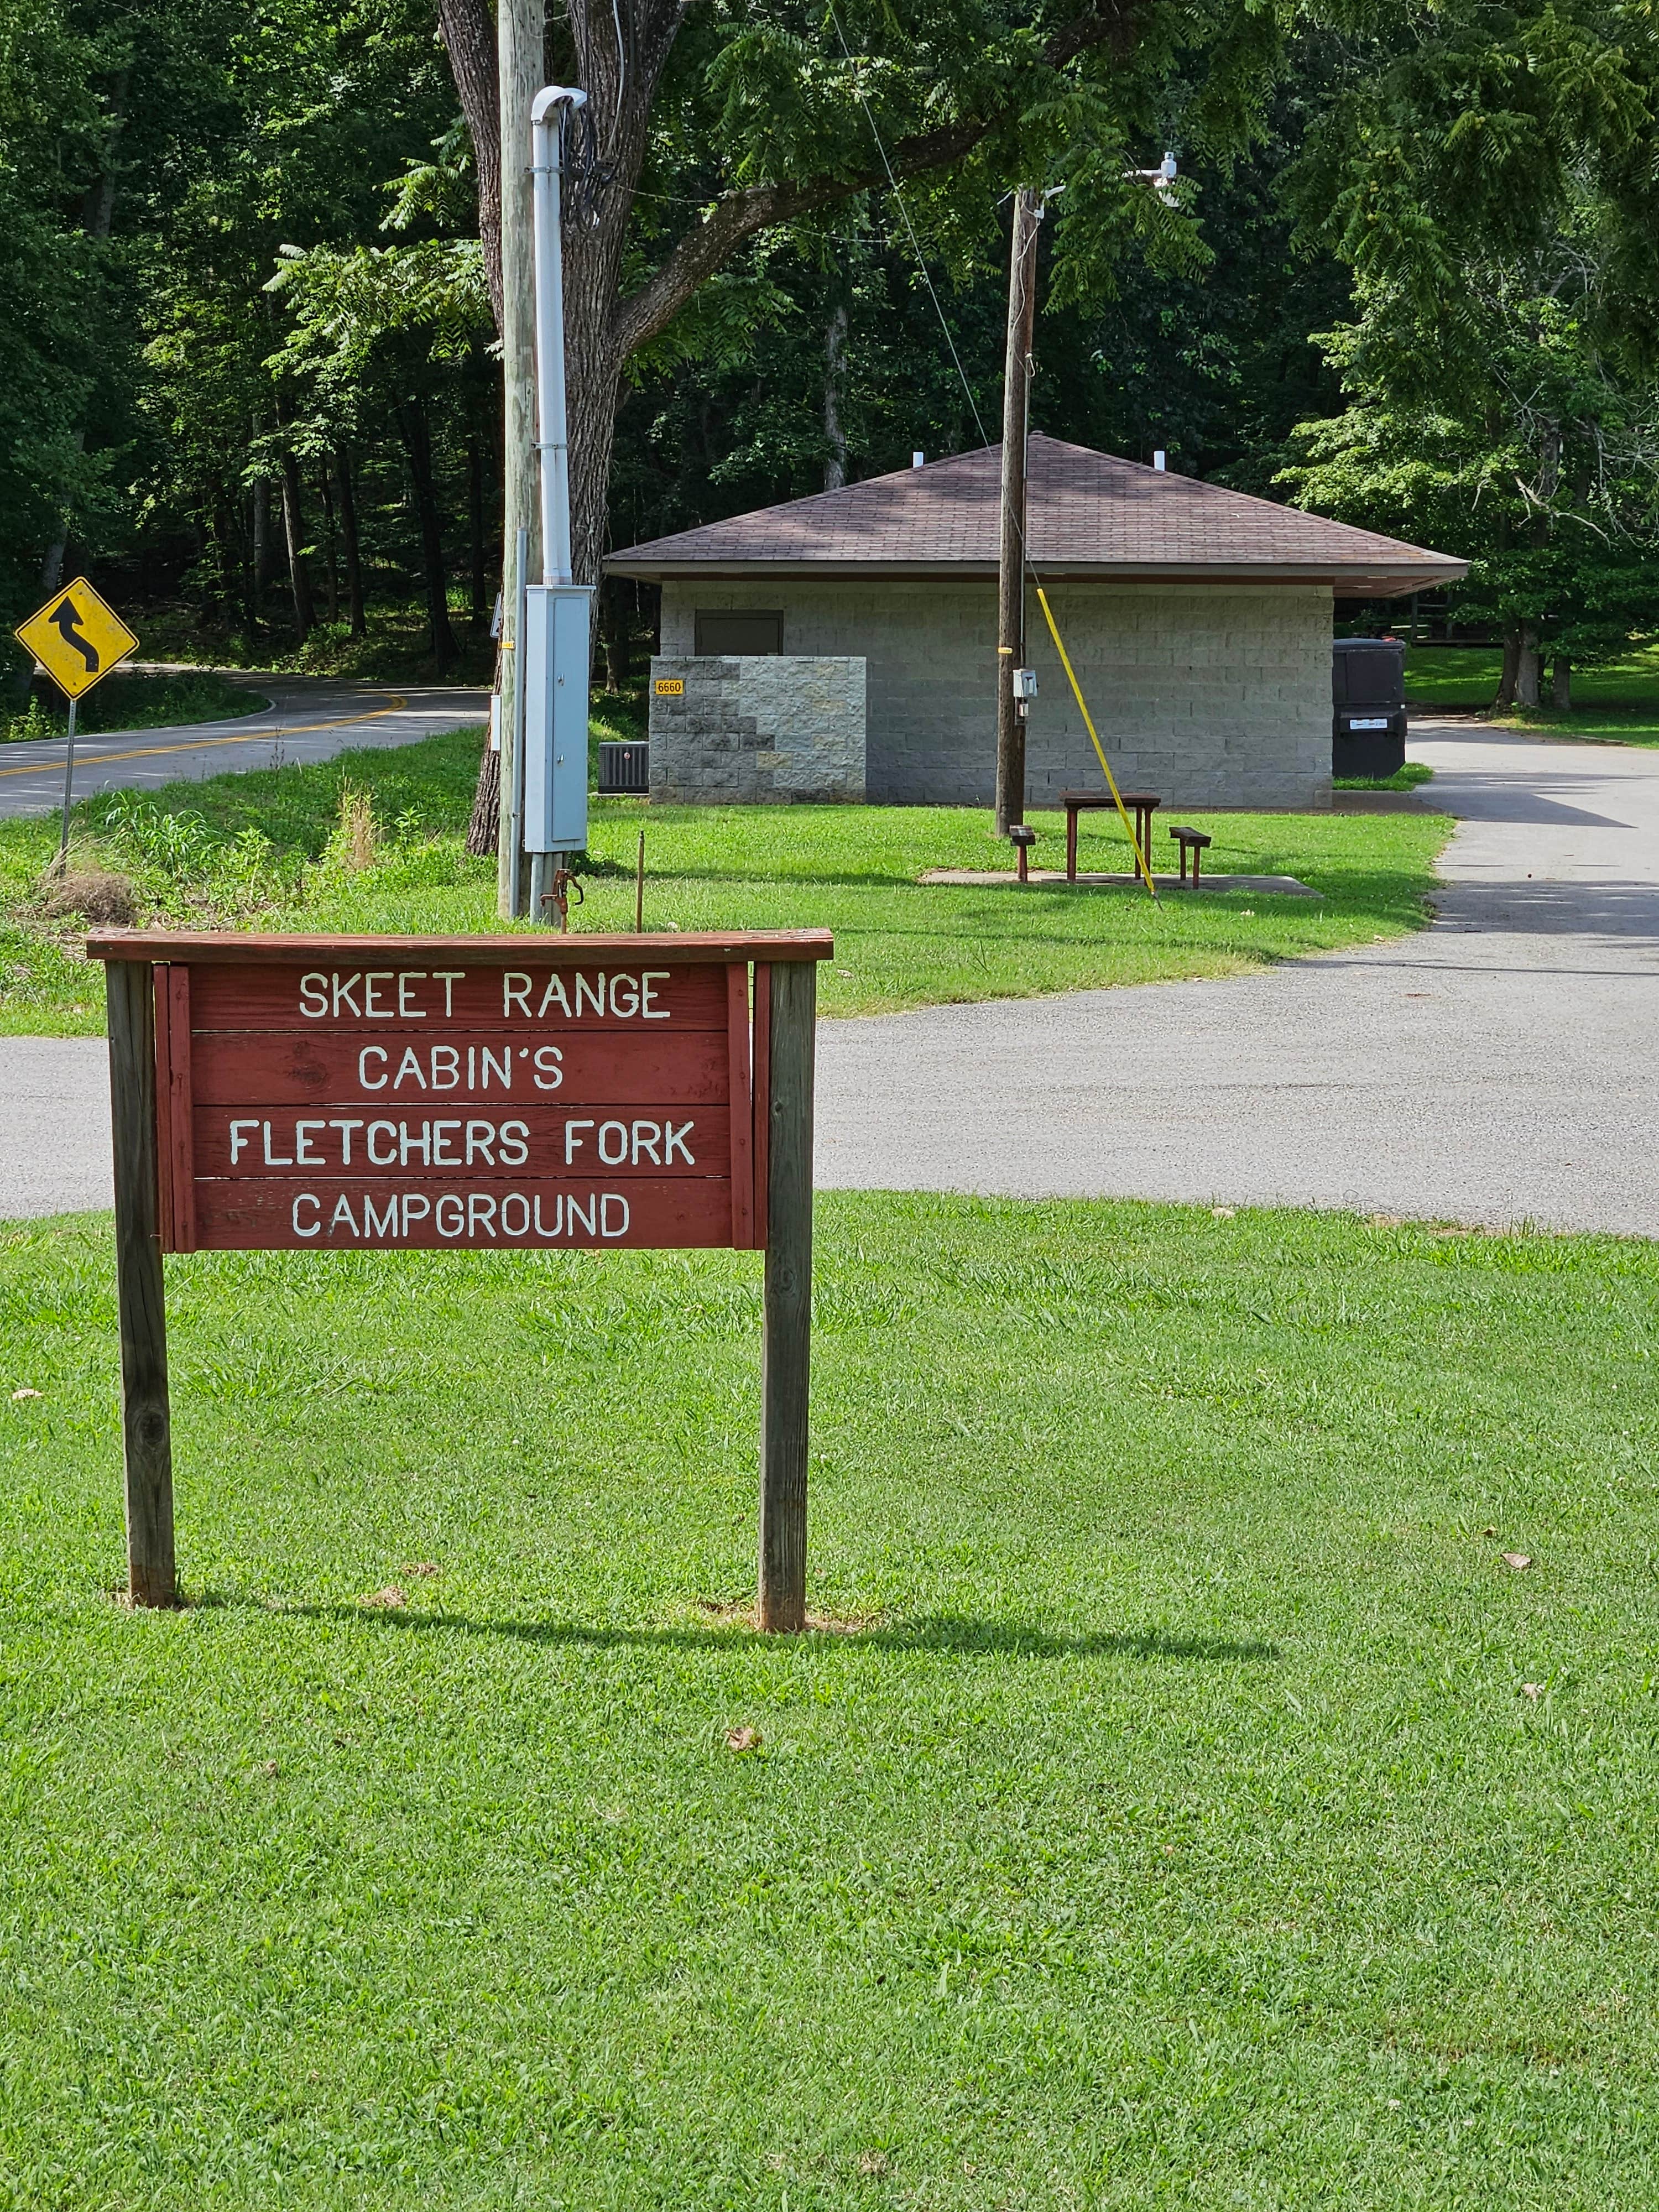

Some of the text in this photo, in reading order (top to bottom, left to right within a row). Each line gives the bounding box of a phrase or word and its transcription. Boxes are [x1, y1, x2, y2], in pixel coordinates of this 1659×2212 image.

[658, 682, 681, 692] 6660
[299, 972, 671, 1019] SKEET RANGE
[359, 1045, 563, 1090] CABIN'S
[229, 1119, 695, 1166] FLETCHERS FORK
[292, 1193, 629, 1238] CAMPGROUND
